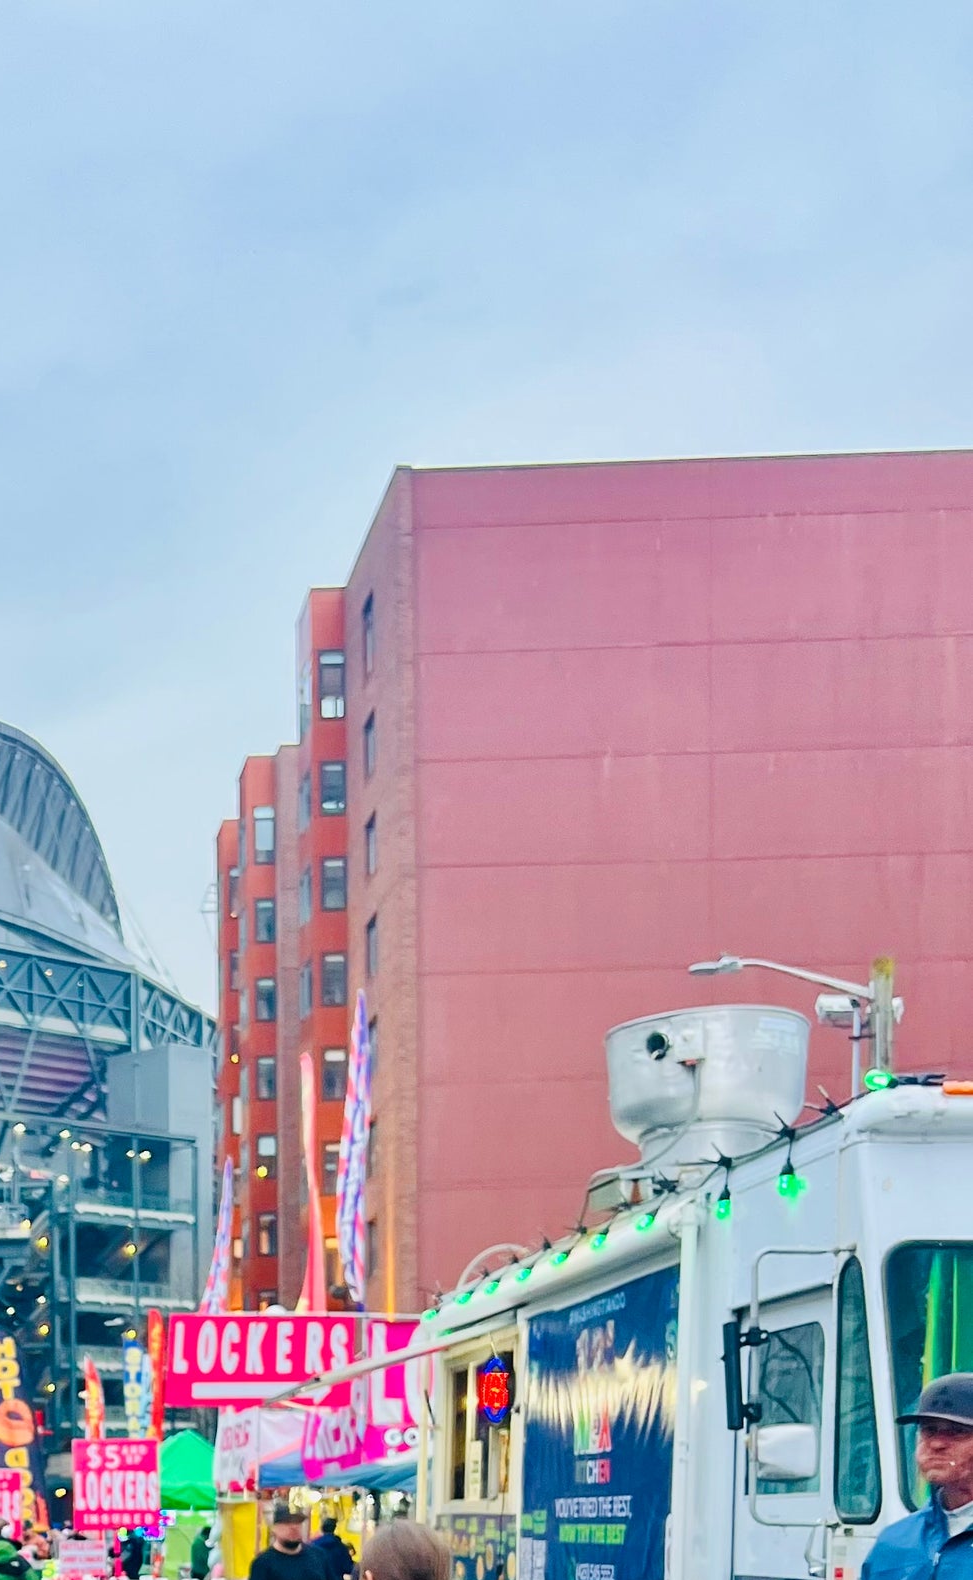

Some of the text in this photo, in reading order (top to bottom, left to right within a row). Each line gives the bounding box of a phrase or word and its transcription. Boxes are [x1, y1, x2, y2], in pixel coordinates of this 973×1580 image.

[172, 1320, 349, 1375] LOCKERS
[87, 1444, 121, 1469] $5
[75, 1470, 159, 1511] LOCKERS
